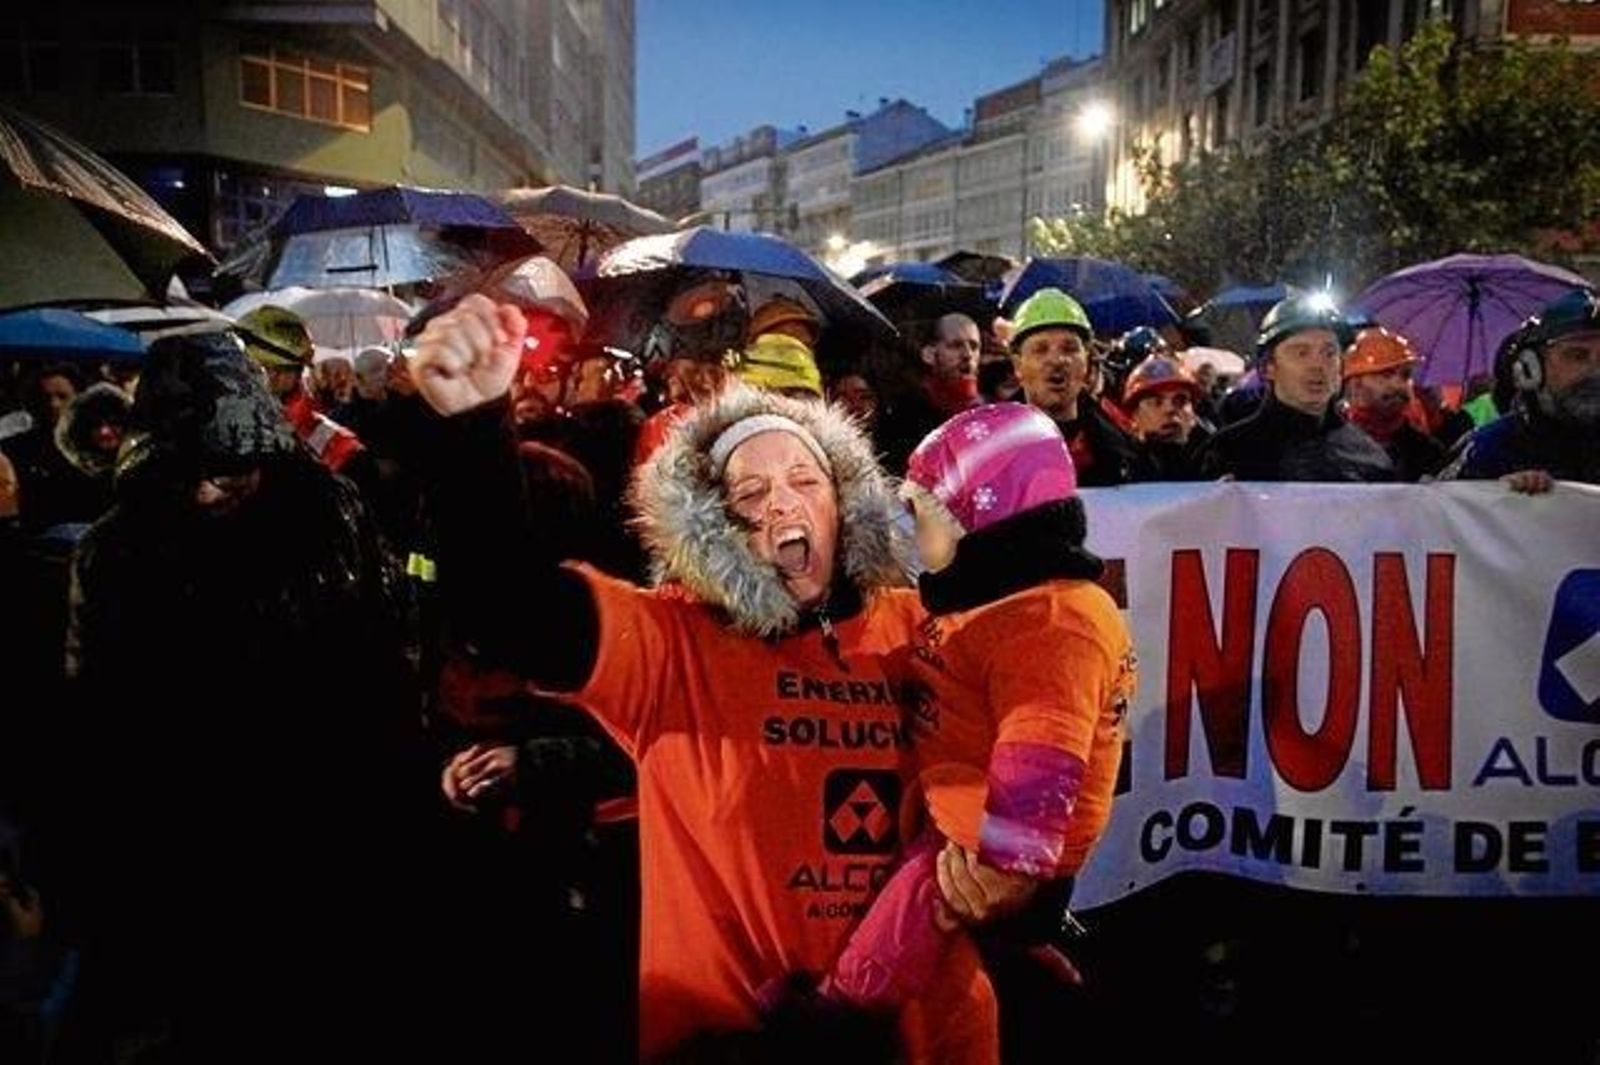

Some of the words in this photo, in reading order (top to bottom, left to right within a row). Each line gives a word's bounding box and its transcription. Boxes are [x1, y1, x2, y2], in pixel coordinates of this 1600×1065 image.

[777, 671, 898, 706] ENERX
[1164, 546, 1456, 792] NON
[763, 716, 910, 750] SOLUCI
[1140, 806, 1425, 873] COMITÉ
[1454, 820, 1550, 873] DE
